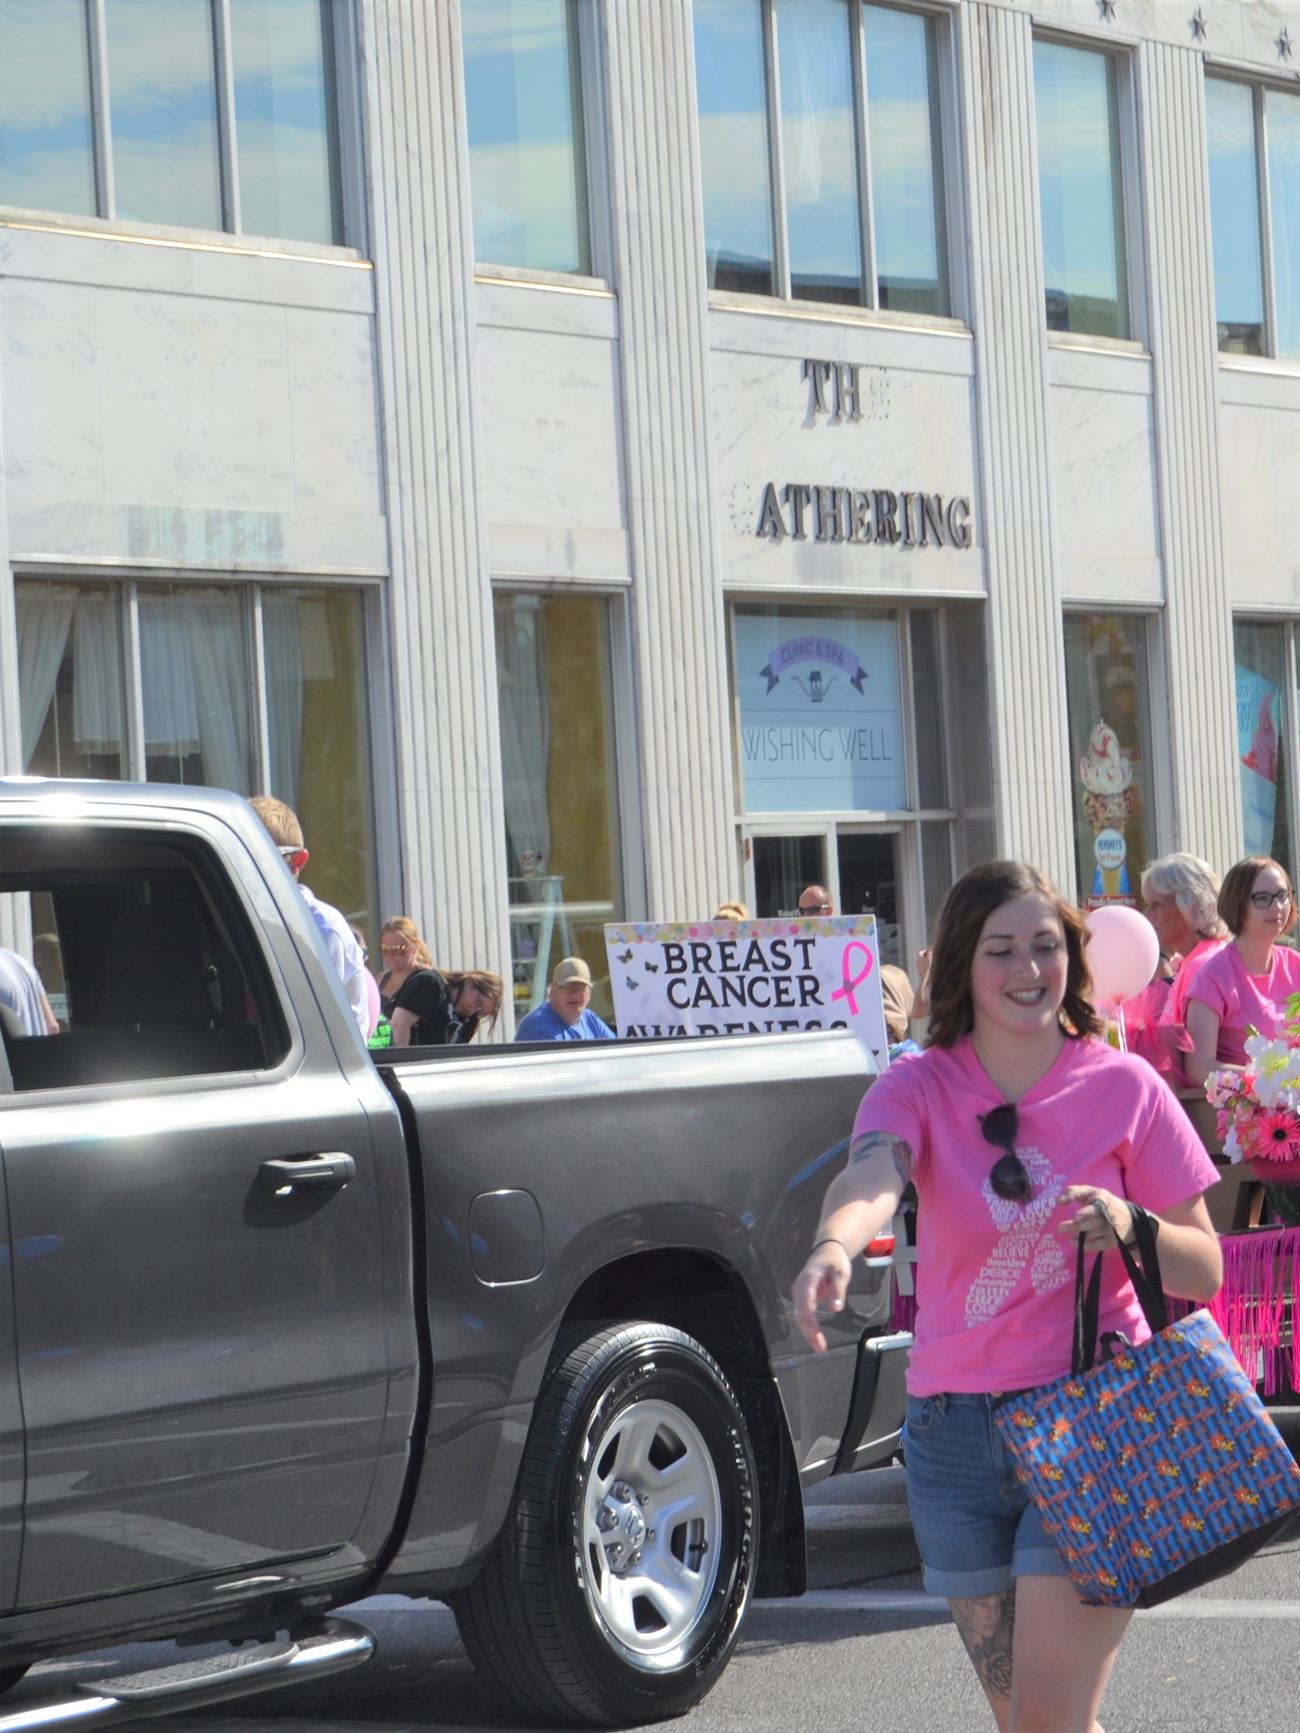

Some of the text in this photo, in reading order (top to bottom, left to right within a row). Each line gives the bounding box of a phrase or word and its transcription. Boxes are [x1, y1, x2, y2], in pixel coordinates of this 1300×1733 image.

[780, 641, 845, 665] CLINIC & SPA
[742, 727, 893, 763] WISHING WELL
[661, 938, 817, 975] BREAST
[666, 974, 825, 1010] CANCER
[991, 1247, 1030, 1258] BELIEVE
[979, 1267, 1021, 1278] peace
[969, 1285, 1009, 1296] faith
